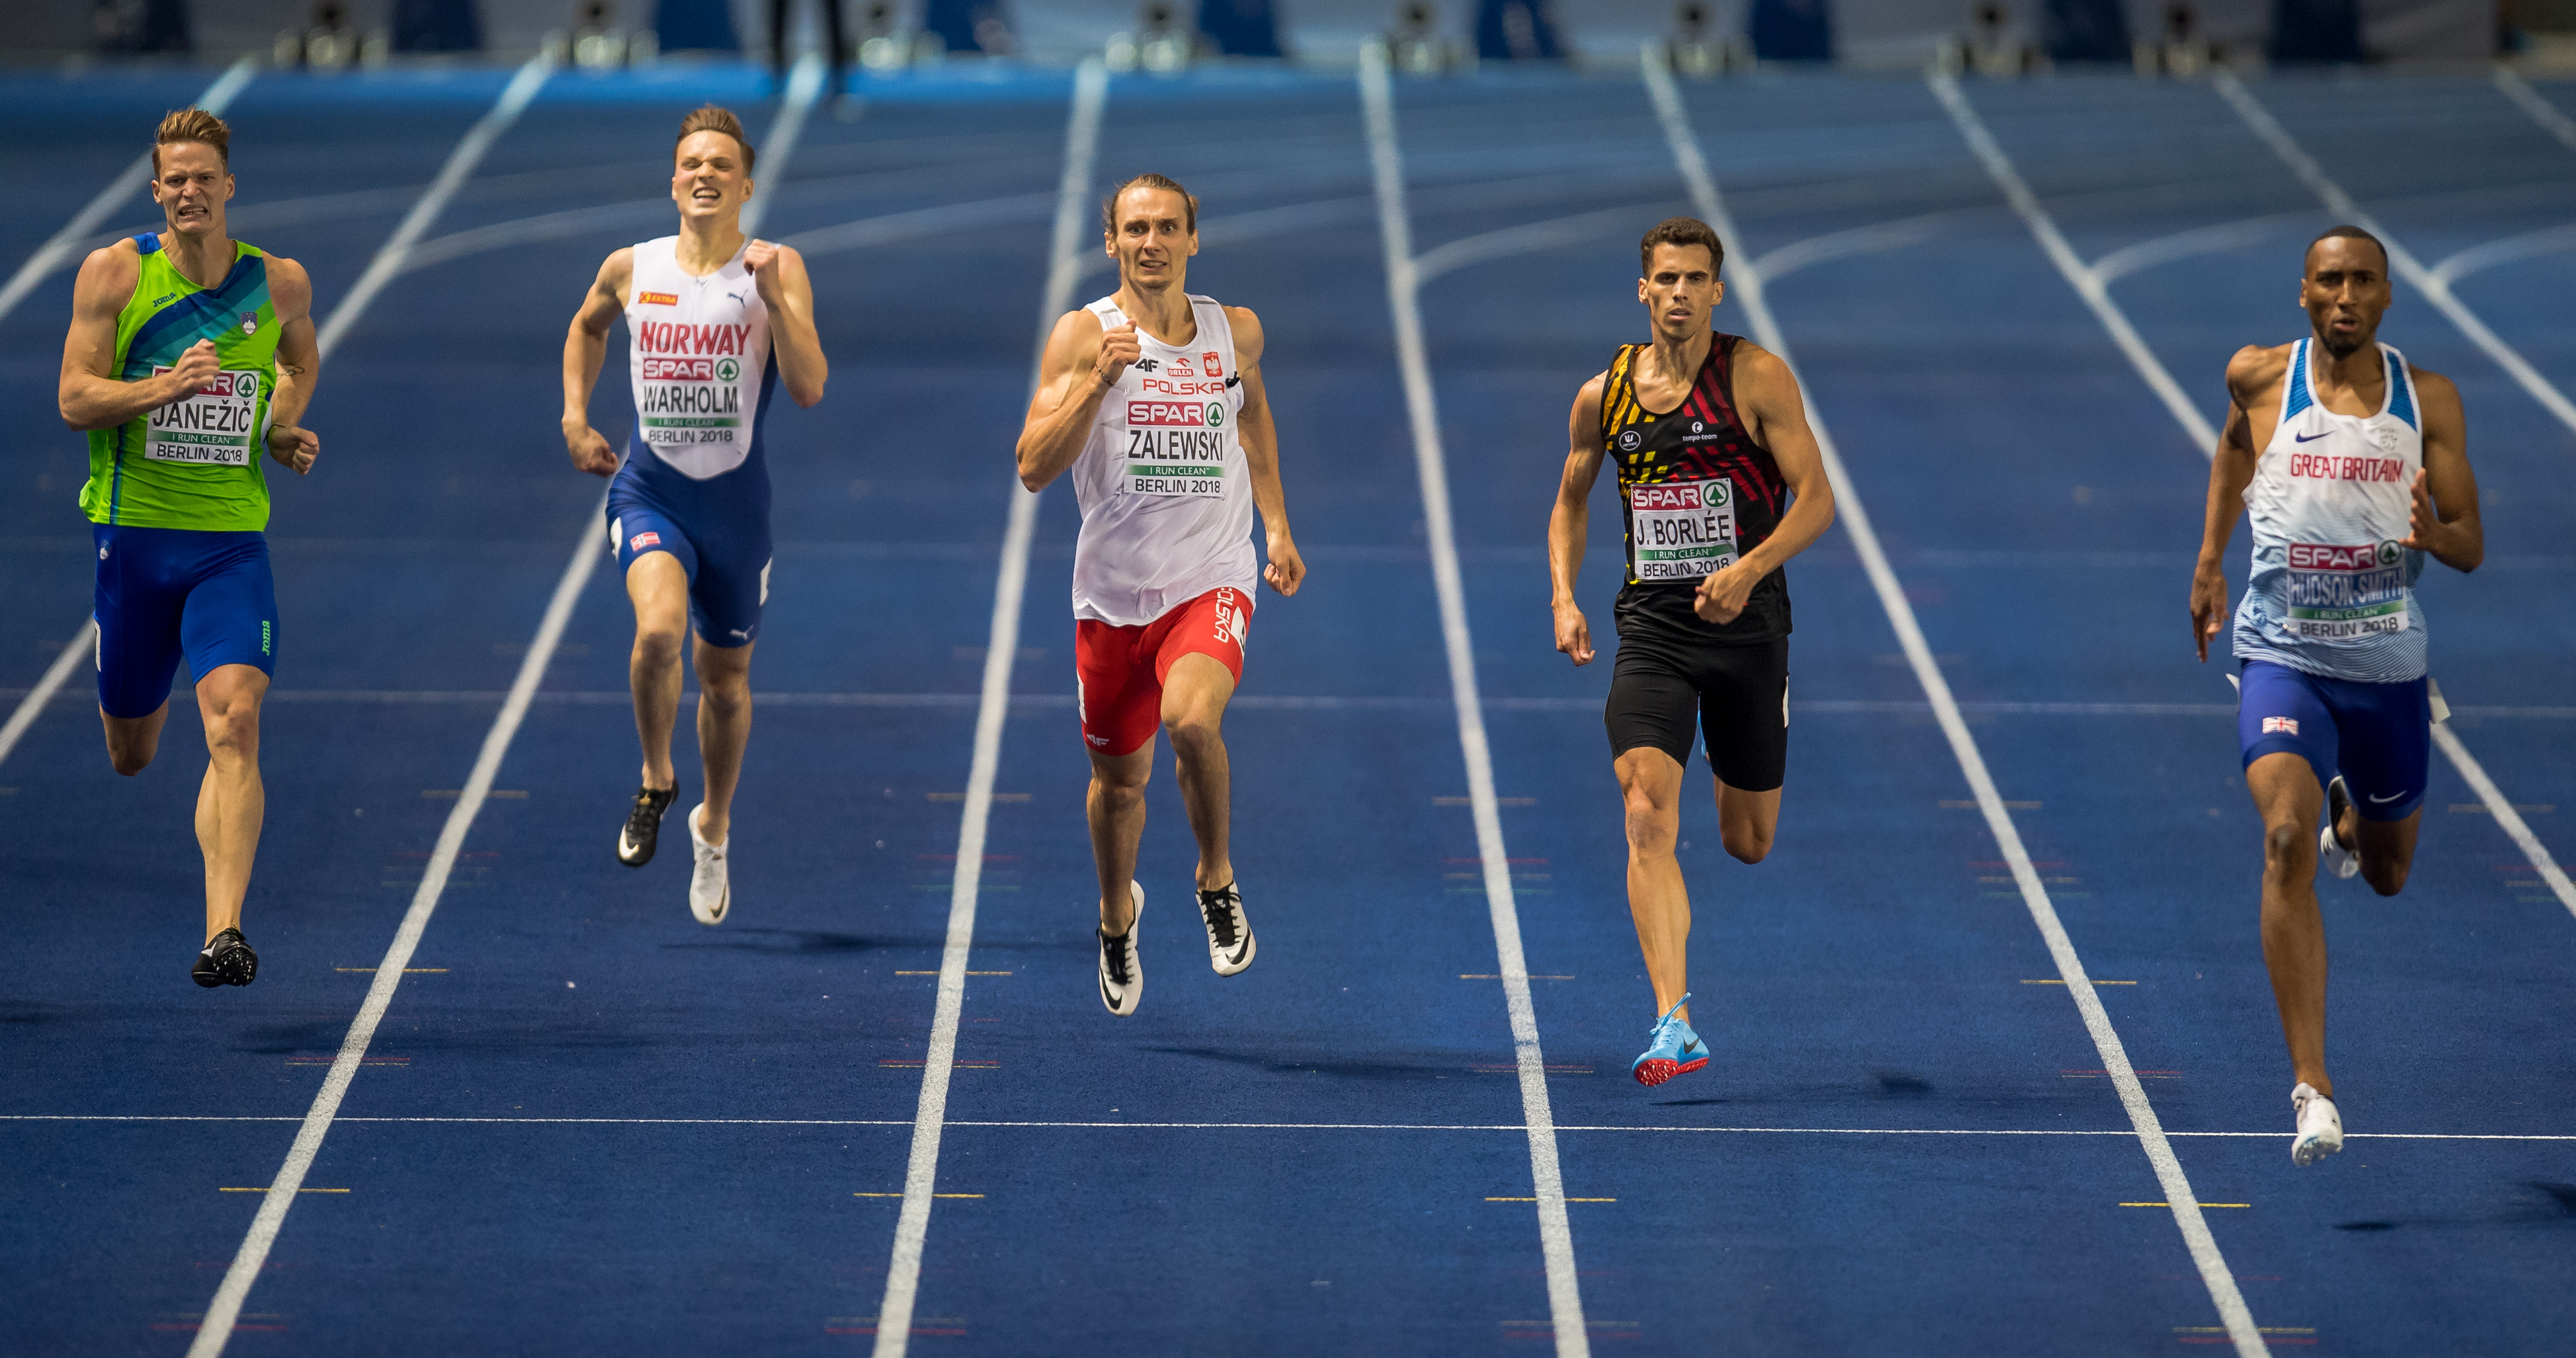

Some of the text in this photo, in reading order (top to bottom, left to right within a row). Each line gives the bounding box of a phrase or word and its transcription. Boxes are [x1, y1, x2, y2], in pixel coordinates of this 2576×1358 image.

[640, 321, 751, 356] NORWAY
[644, 360, 712, 379] SPAR
[1143, 378, 1225, 395] POLSKA
[644, 385, 738, 413] WARHOLM
[152, 399, 251, 432] JANEŽIČ
[663, 418, 684, 426] RUN
[1130, 403, 1202, 422] SPAR
[178, 433, 198, 442] RUN
[649, 430, 733, 442] BERLIN 2018
[1128, 430, 1224, 461] ZALEWSKI
[1683, 434, 1718, 443] tempo-team
[157, 444, 242, 462] BERLIN 2018
[1155, 467, 1175, 475] RUN
[2290, 453, 2404, 482] GREAT BRITAIN
[1135, 479, 1220, 493] BERLIN 2018
[1634, 487, 1700, 507] SPAR
[1637, 510, 1731, 545] J. BORLÉE
[1659, 551, 1676, 559] RUN
[2291, 546, 2374, 568] SPAR
[1643, 557, 1730, 577] BERLIN 2018
[1213, 588, 1234, 643] OLSKA
[2300, 616, 2399, 637] BERLIN 2018
